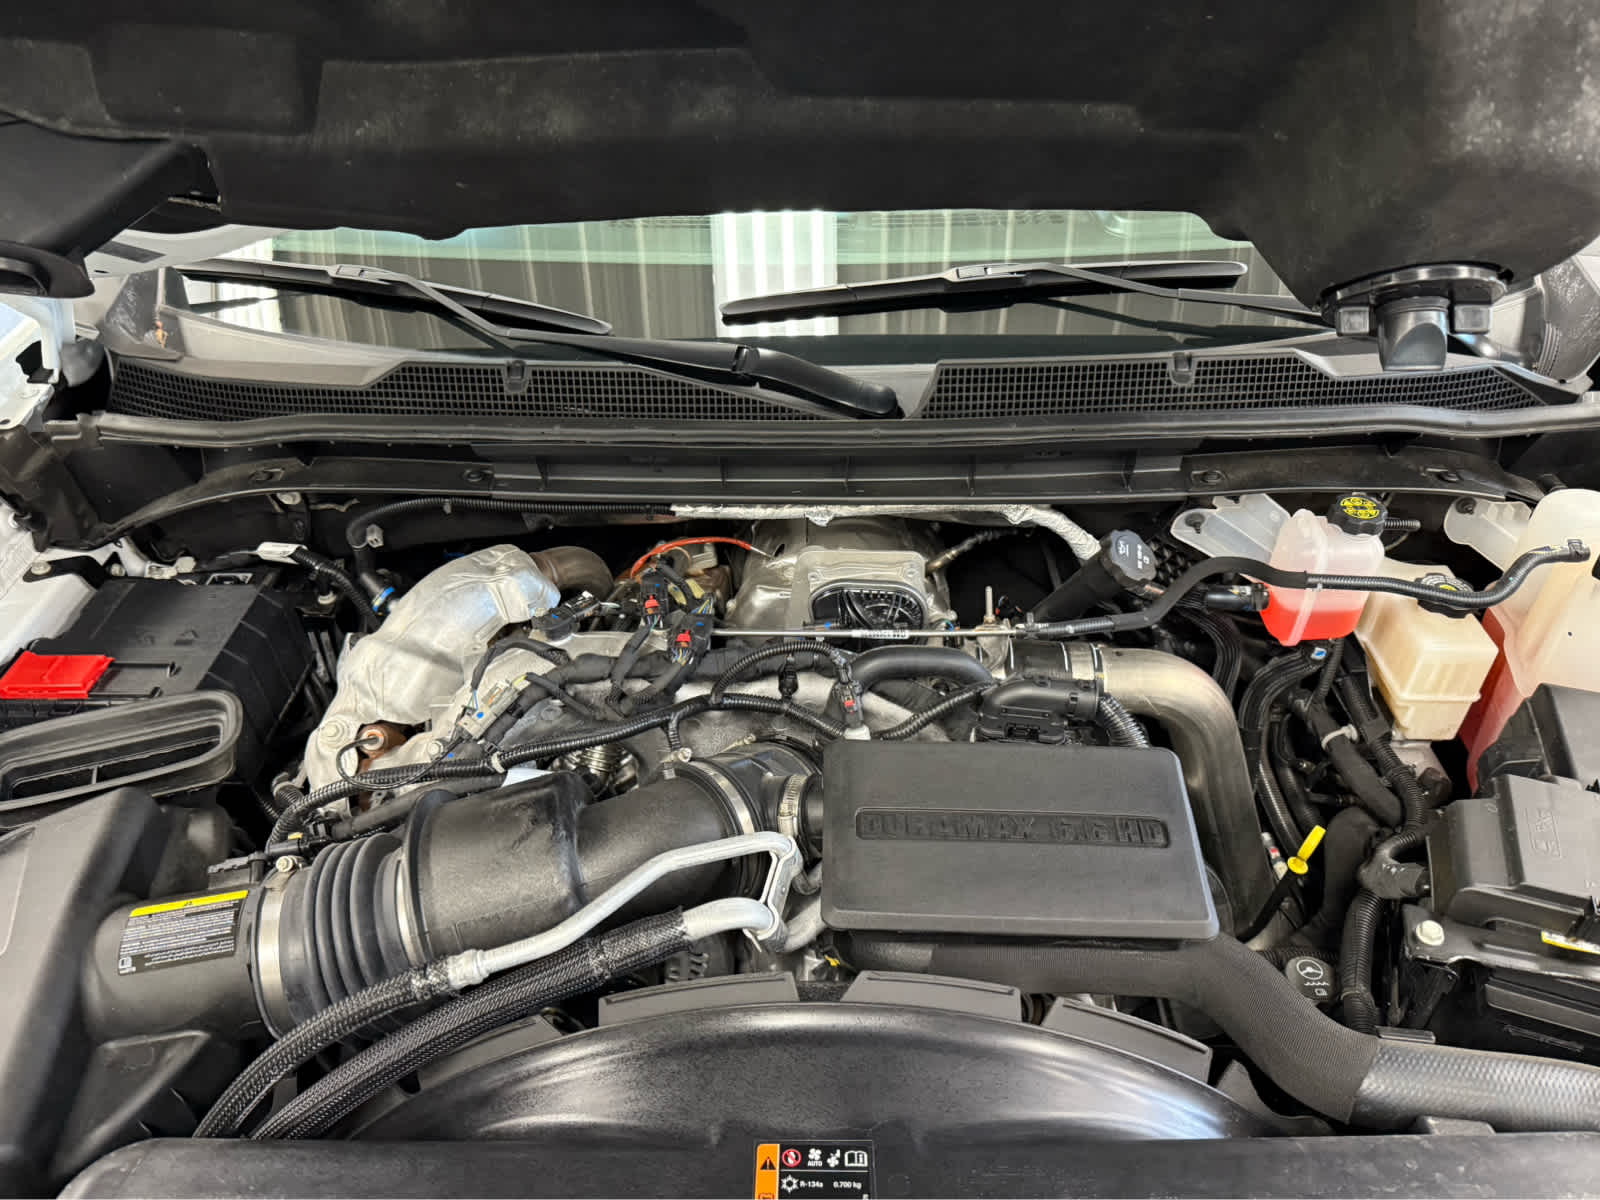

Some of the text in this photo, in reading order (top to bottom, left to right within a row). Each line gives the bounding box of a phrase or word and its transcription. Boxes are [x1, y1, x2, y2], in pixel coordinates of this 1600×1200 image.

[860, 813, 1035, 839] DURAMAX
[799, 1180, 824, 1188] R-134a
[852, 1181, 862, 1190] kg
